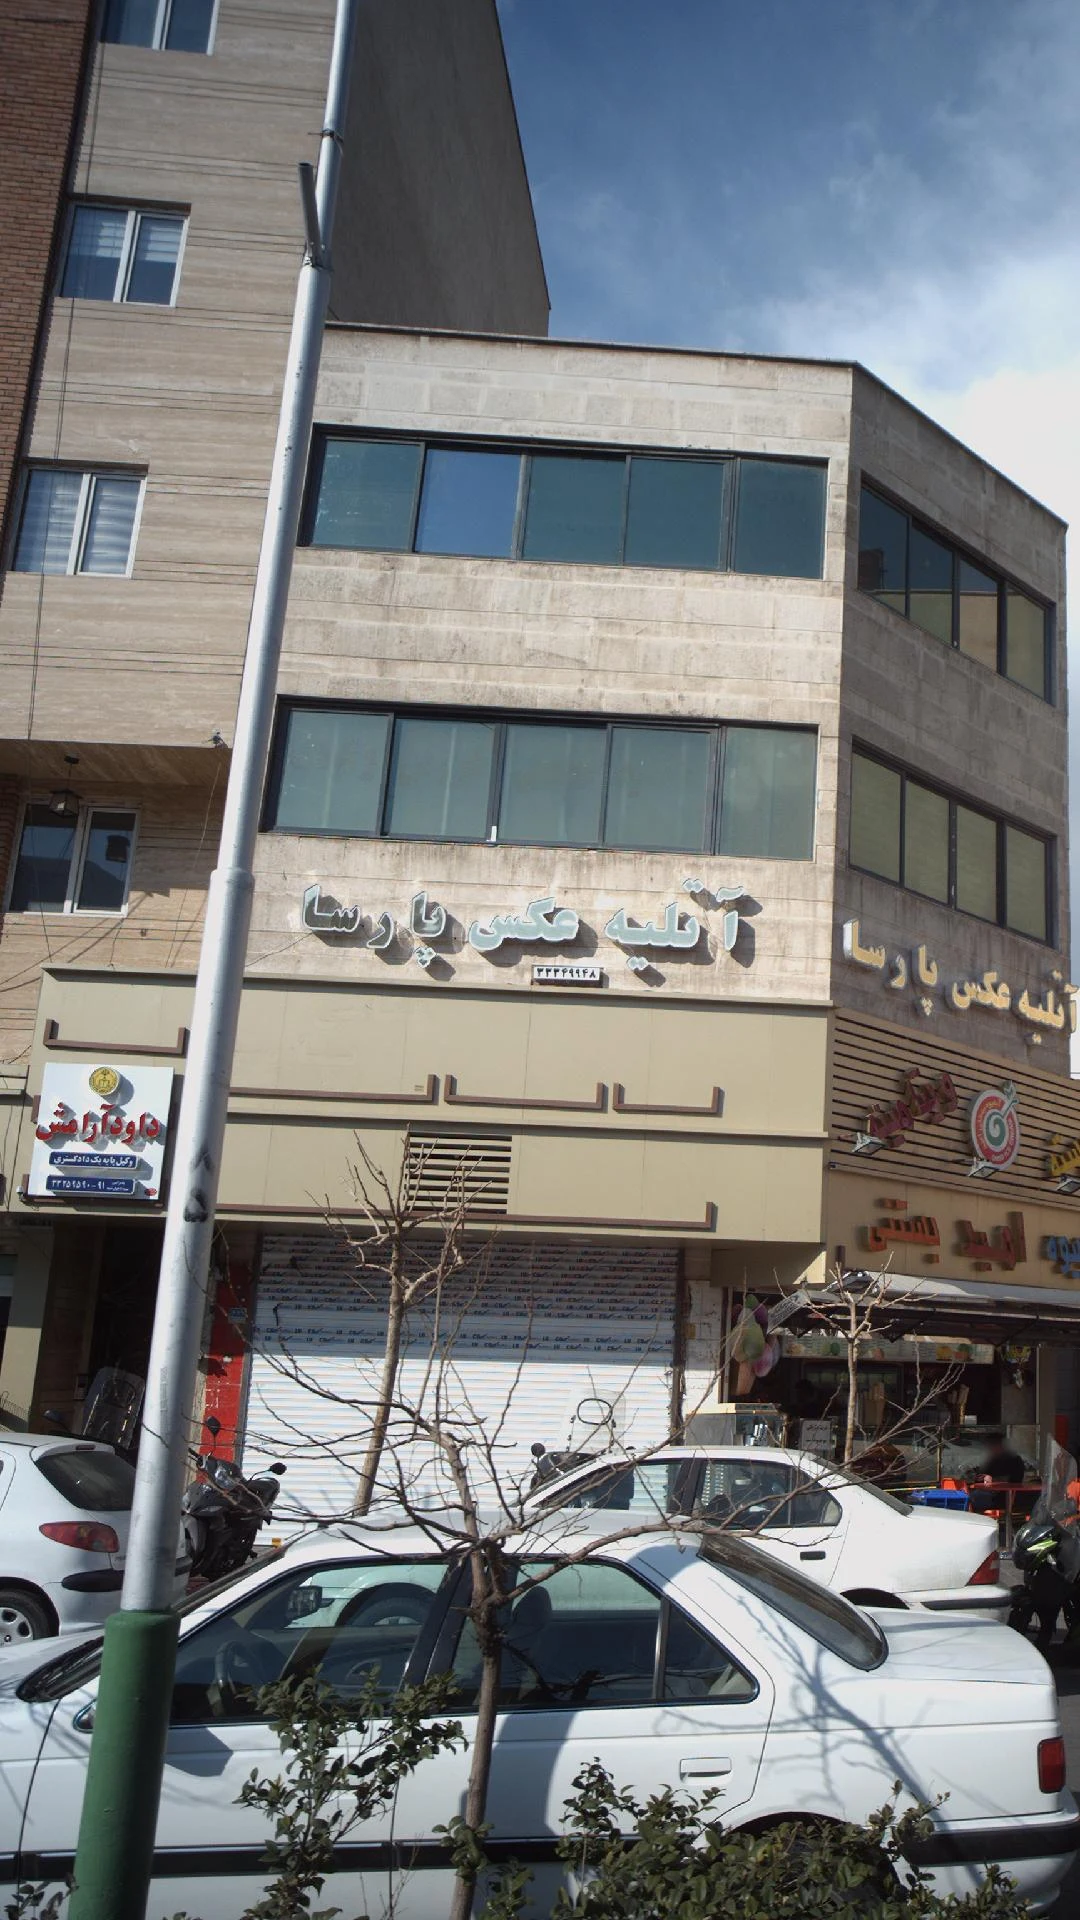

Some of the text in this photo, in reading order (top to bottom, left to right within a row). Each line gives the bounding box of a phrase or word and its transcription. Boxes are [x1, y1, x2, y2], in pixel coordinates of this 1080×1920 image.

[301, 877, 747, 972] آتلیه عکس پارسا
[843, 918, 939, 1017] پارسا
[951, 971, 1011, 1010] عکس
[36, 1102, 160, 1145] داود آرامش
[116, 1155, 134, 1168] وکیل
